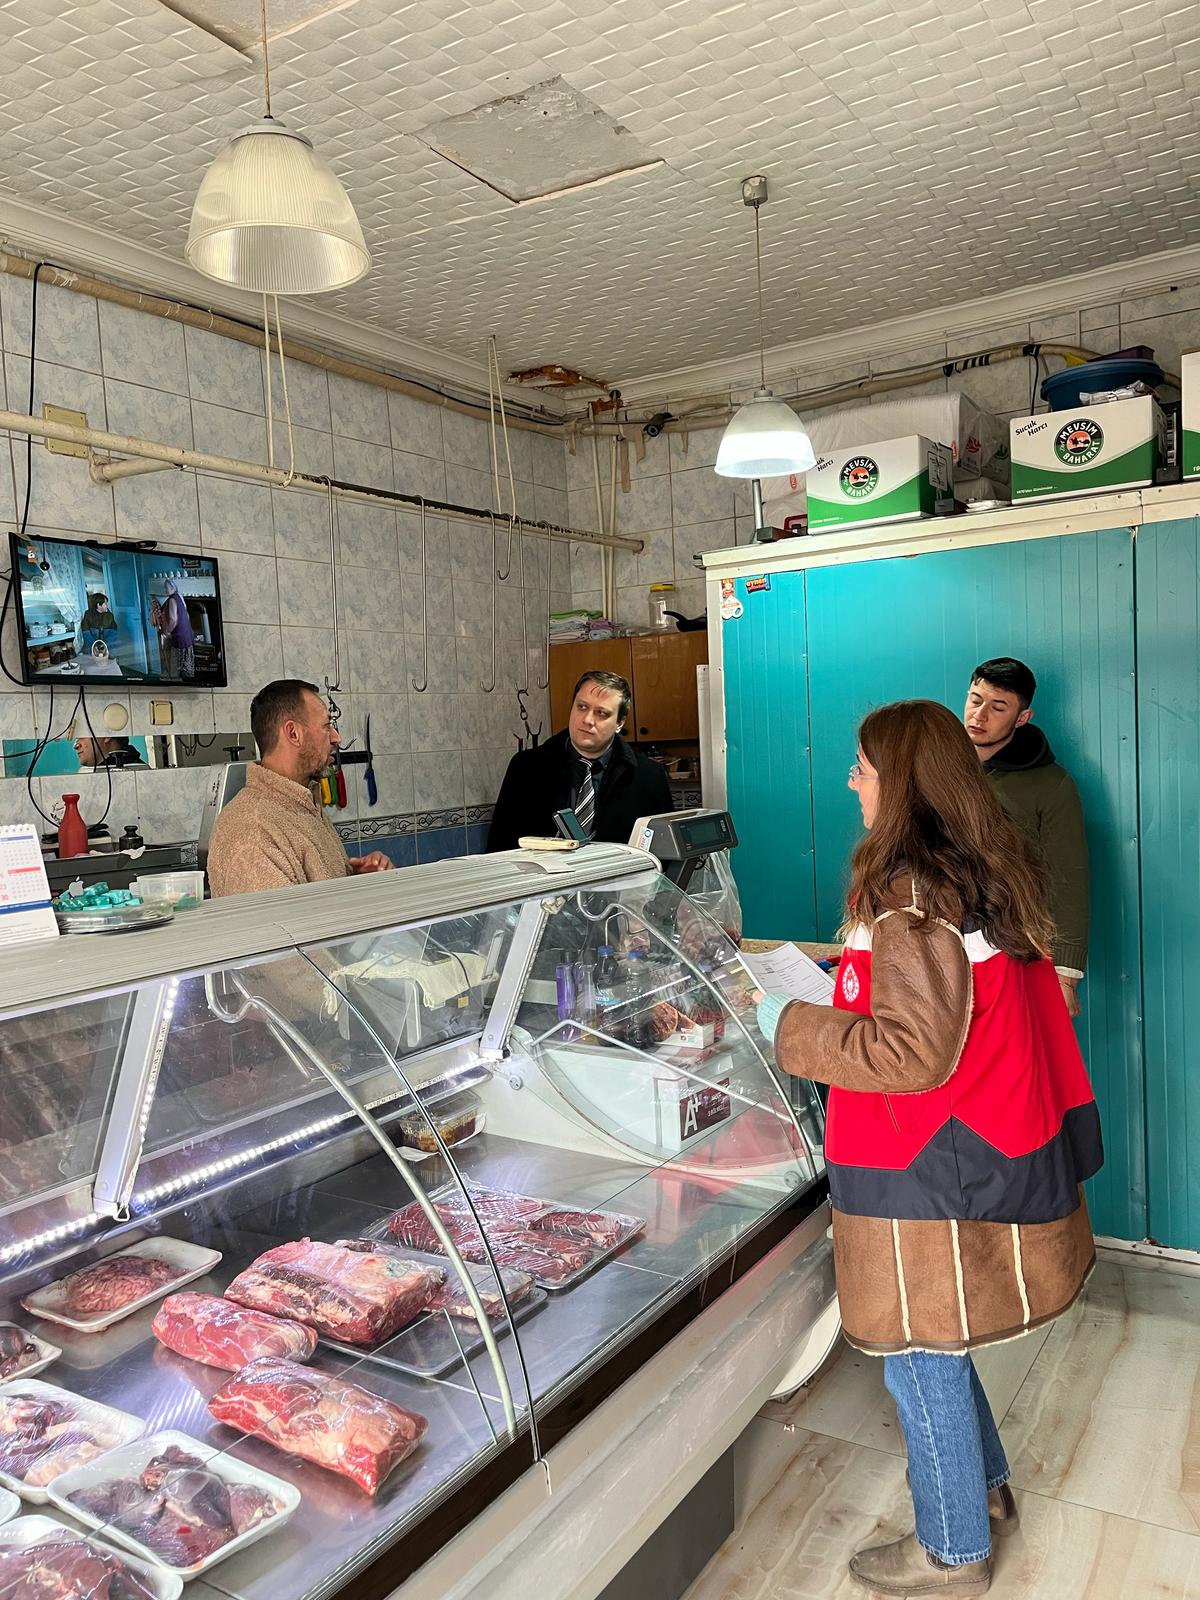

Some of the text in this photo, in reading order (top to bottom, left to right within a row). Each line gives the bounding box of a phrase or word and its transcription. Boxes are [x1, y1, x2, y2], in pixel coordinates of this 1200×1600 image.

[1015, 420, 1037, 436] Sucuk
[1027, 422, 1048, 437] Harcı
[1059, 422, 1098, 440] MEVSİM
[1062, 441, 1100, 464] BAHARAT
[843, 459, 875, 476] MEVSİM
[846, 476, 877, 497] BAHARAT
